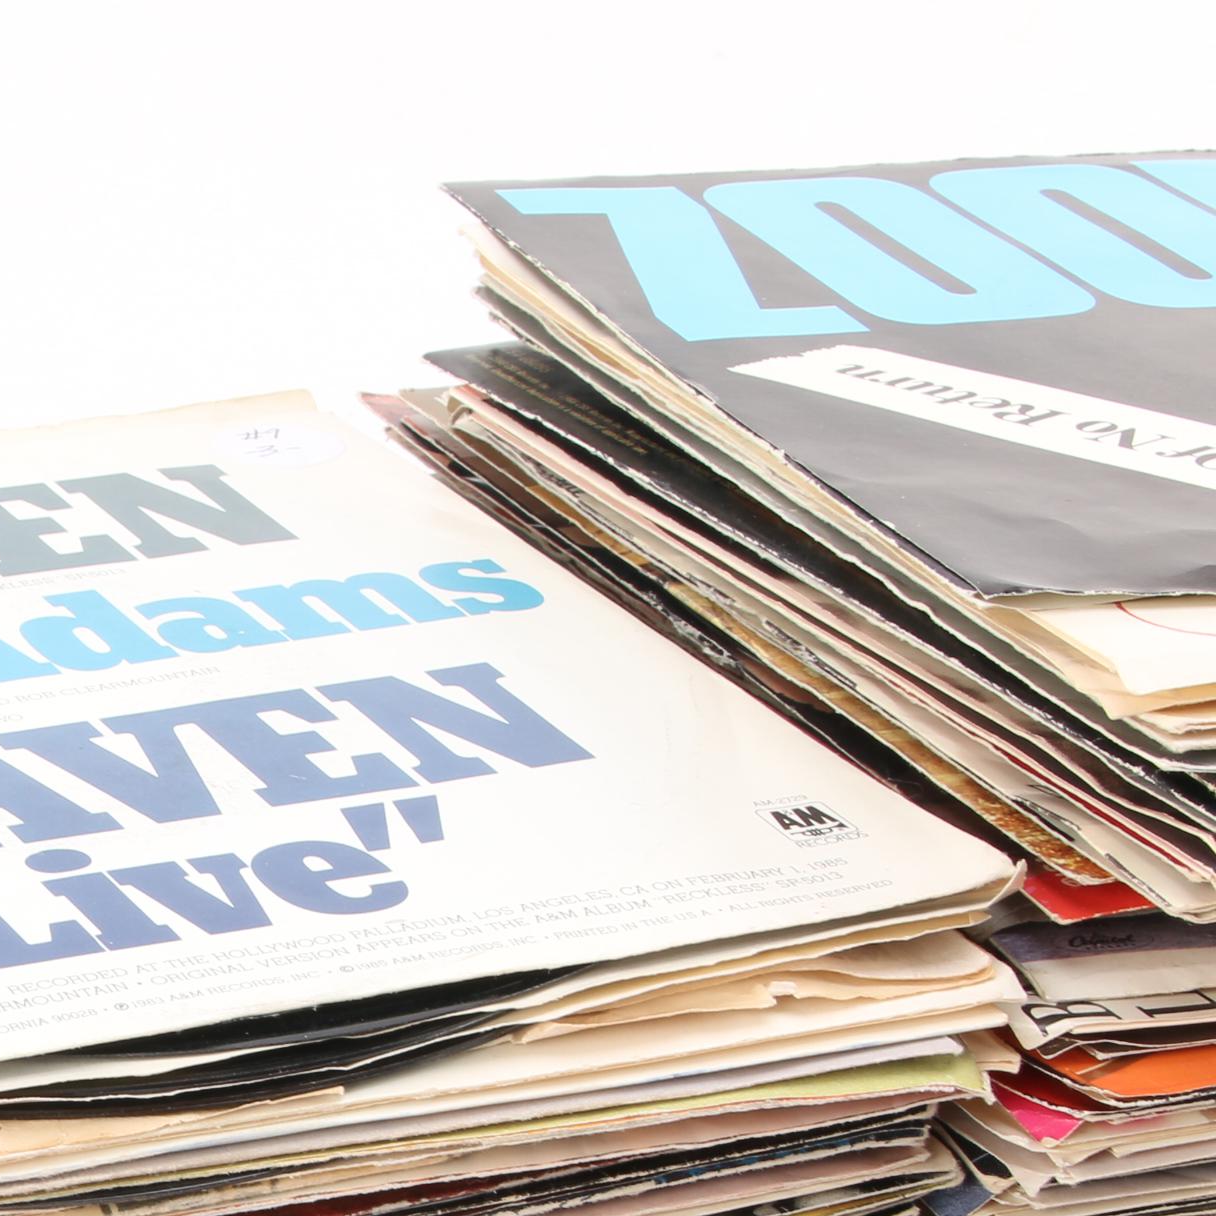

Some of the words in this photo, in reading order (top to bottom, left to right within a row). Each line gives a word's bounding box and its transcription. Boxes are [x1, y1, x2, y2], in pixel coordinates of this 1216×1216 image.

[835, 363, 1072, 427] Return
[1075, 419, 1177, 452] No
[14, 690, 57, 704] BOB
[59, 666, 221, 696] CLEARMOUNTAIN
[7, 967, 129, 995] RECORDED
[136, 961, 160, 975] AT
[163, 954, 210, 969] THE
[211, 933, 346, 961] HOLLYWOOD
[472, 905, 515, 921] LOS
[619, 884, 651, 897] CA
[652, 878, 684, 892] ON
[686, 864, 786, 891] FEBRUARY
[807, 856, 849, 871] 1985
[51, 1008, 99, 1023] 90028
[170, 989, 205, 1002] A&M
[392, 953, 427, 965] A&M
[553, 925, 619, 940] PRINTED
[620, 921, 639, 932] IN
[639, 914, 673, 927] THE
[729, 901, 760, 913] ALL
[757, 893, 815, 908] RIGHTS
[813, 879, 893, 899] RESERVED
[150, 962, 254, 985] ORIGINAL
[256, 946, 350, 968] VERSION
[356, 931, 447, 953] APPEARS
[451, 924, 484, 938] ON
[484, 916, 531, 932] THE
[534, 908, 579, 924] A&M
[584, 898, 652, 917] ALBUM
